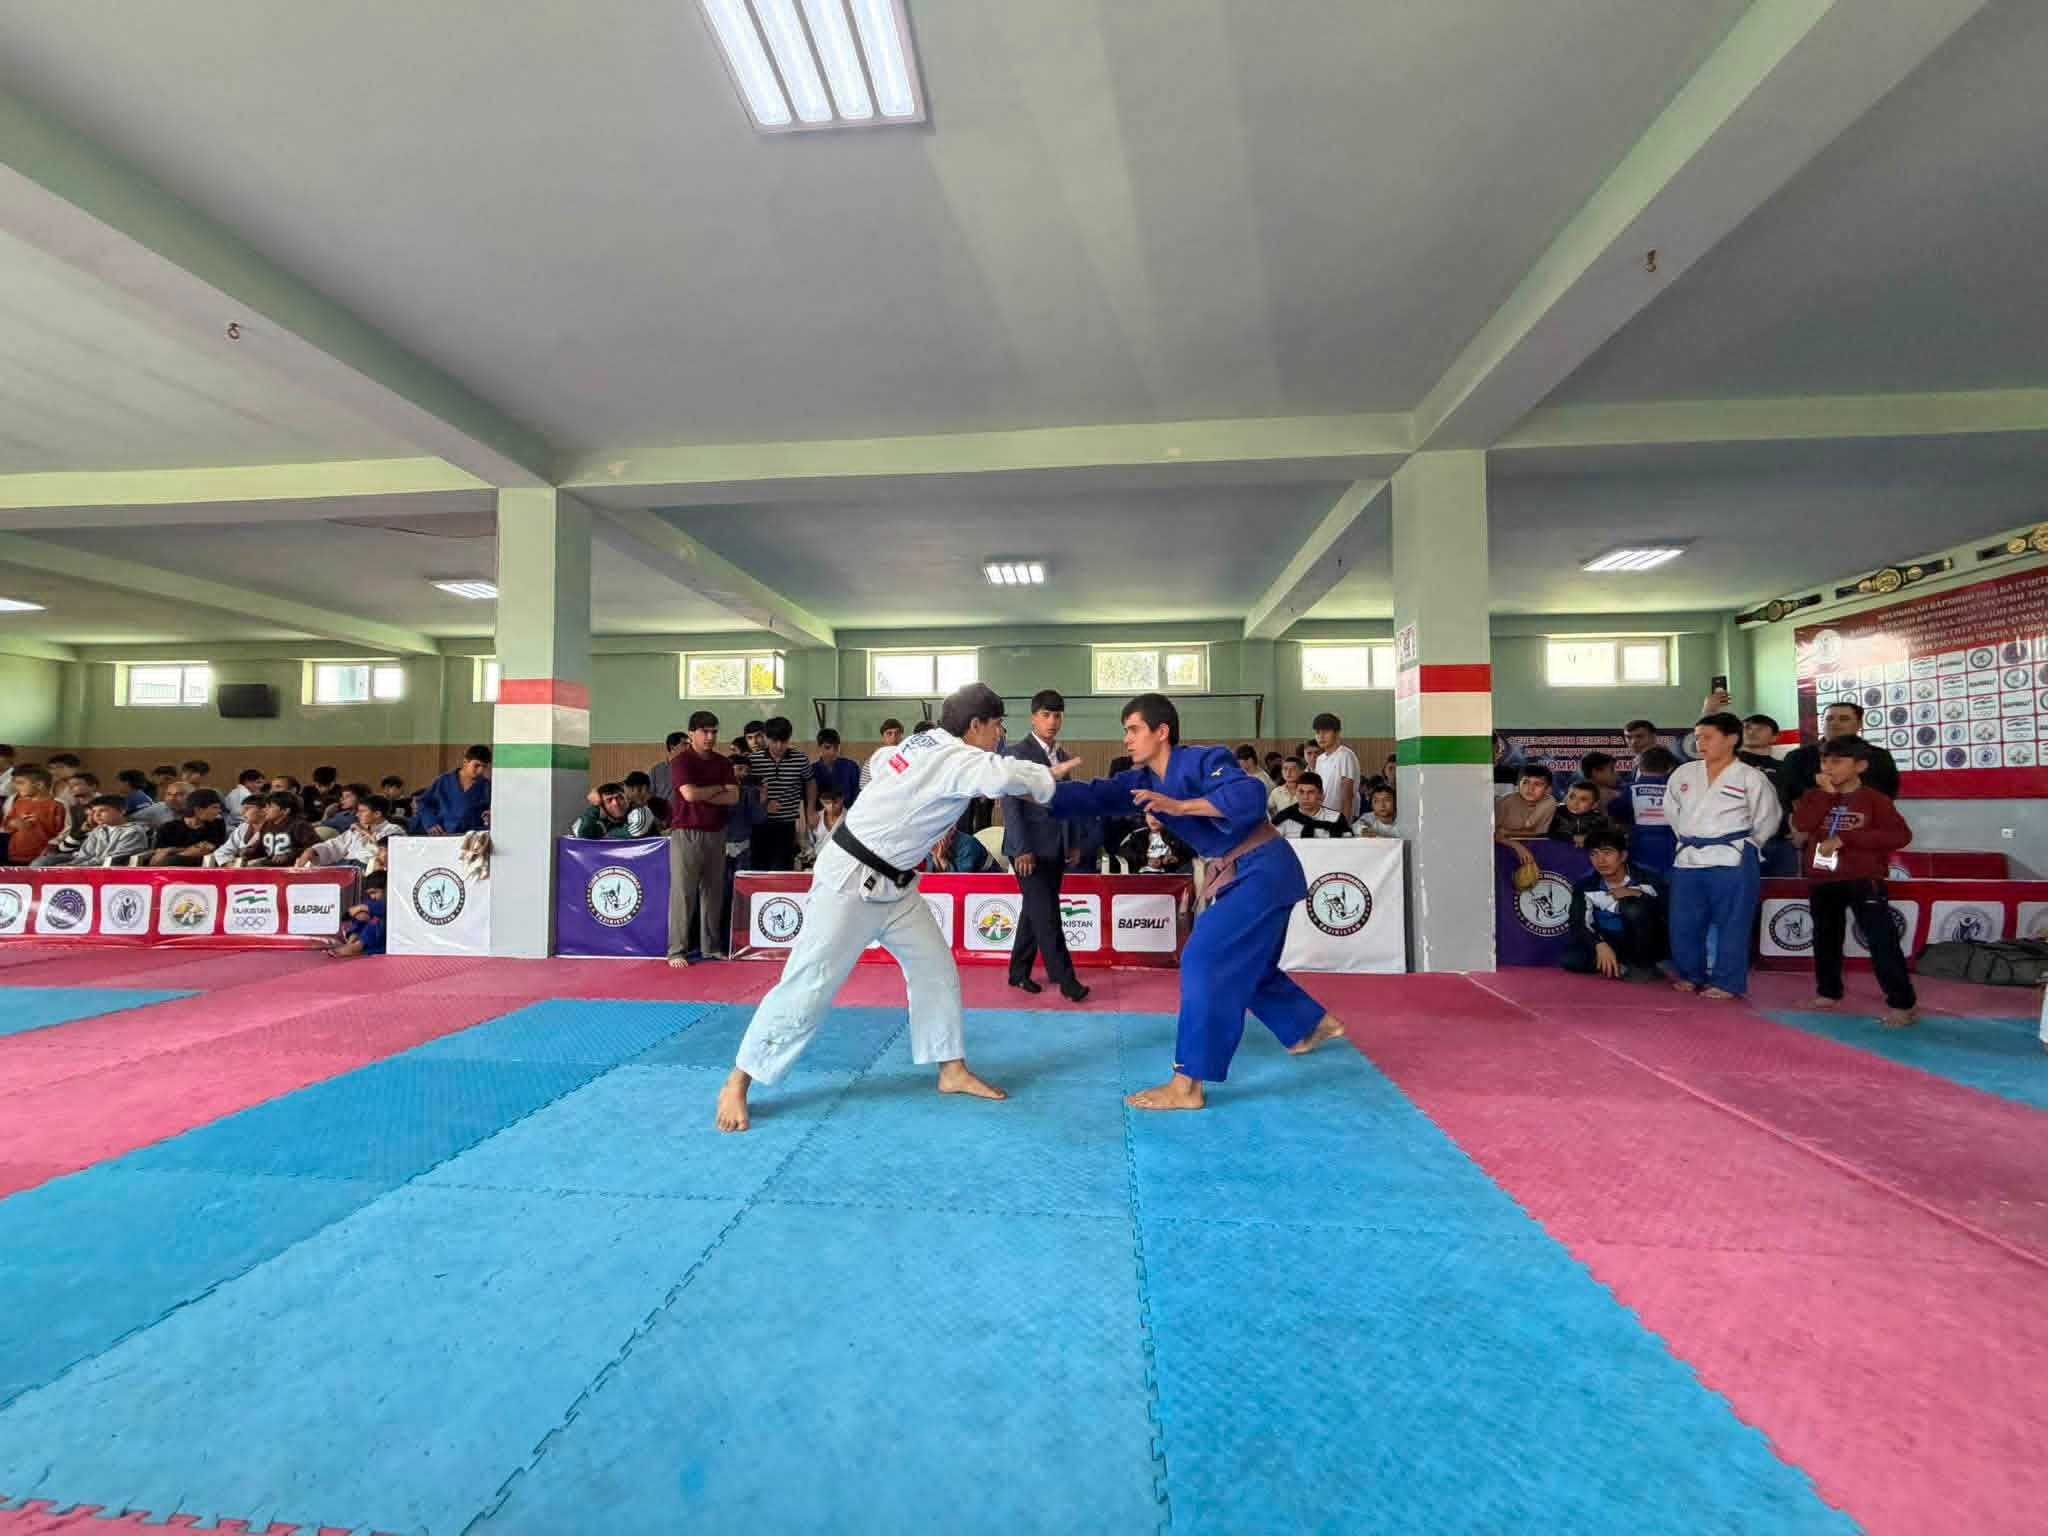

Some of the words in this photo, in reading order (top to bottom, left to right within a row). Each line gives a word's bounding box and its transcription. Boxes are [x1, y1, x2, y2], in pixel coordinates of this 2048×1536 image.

[263, 833, 289, 856] 92
[1063, 919, 1093, 928] KISTAN
[1118, 918, 1166, 929] ВАРЗИШ
